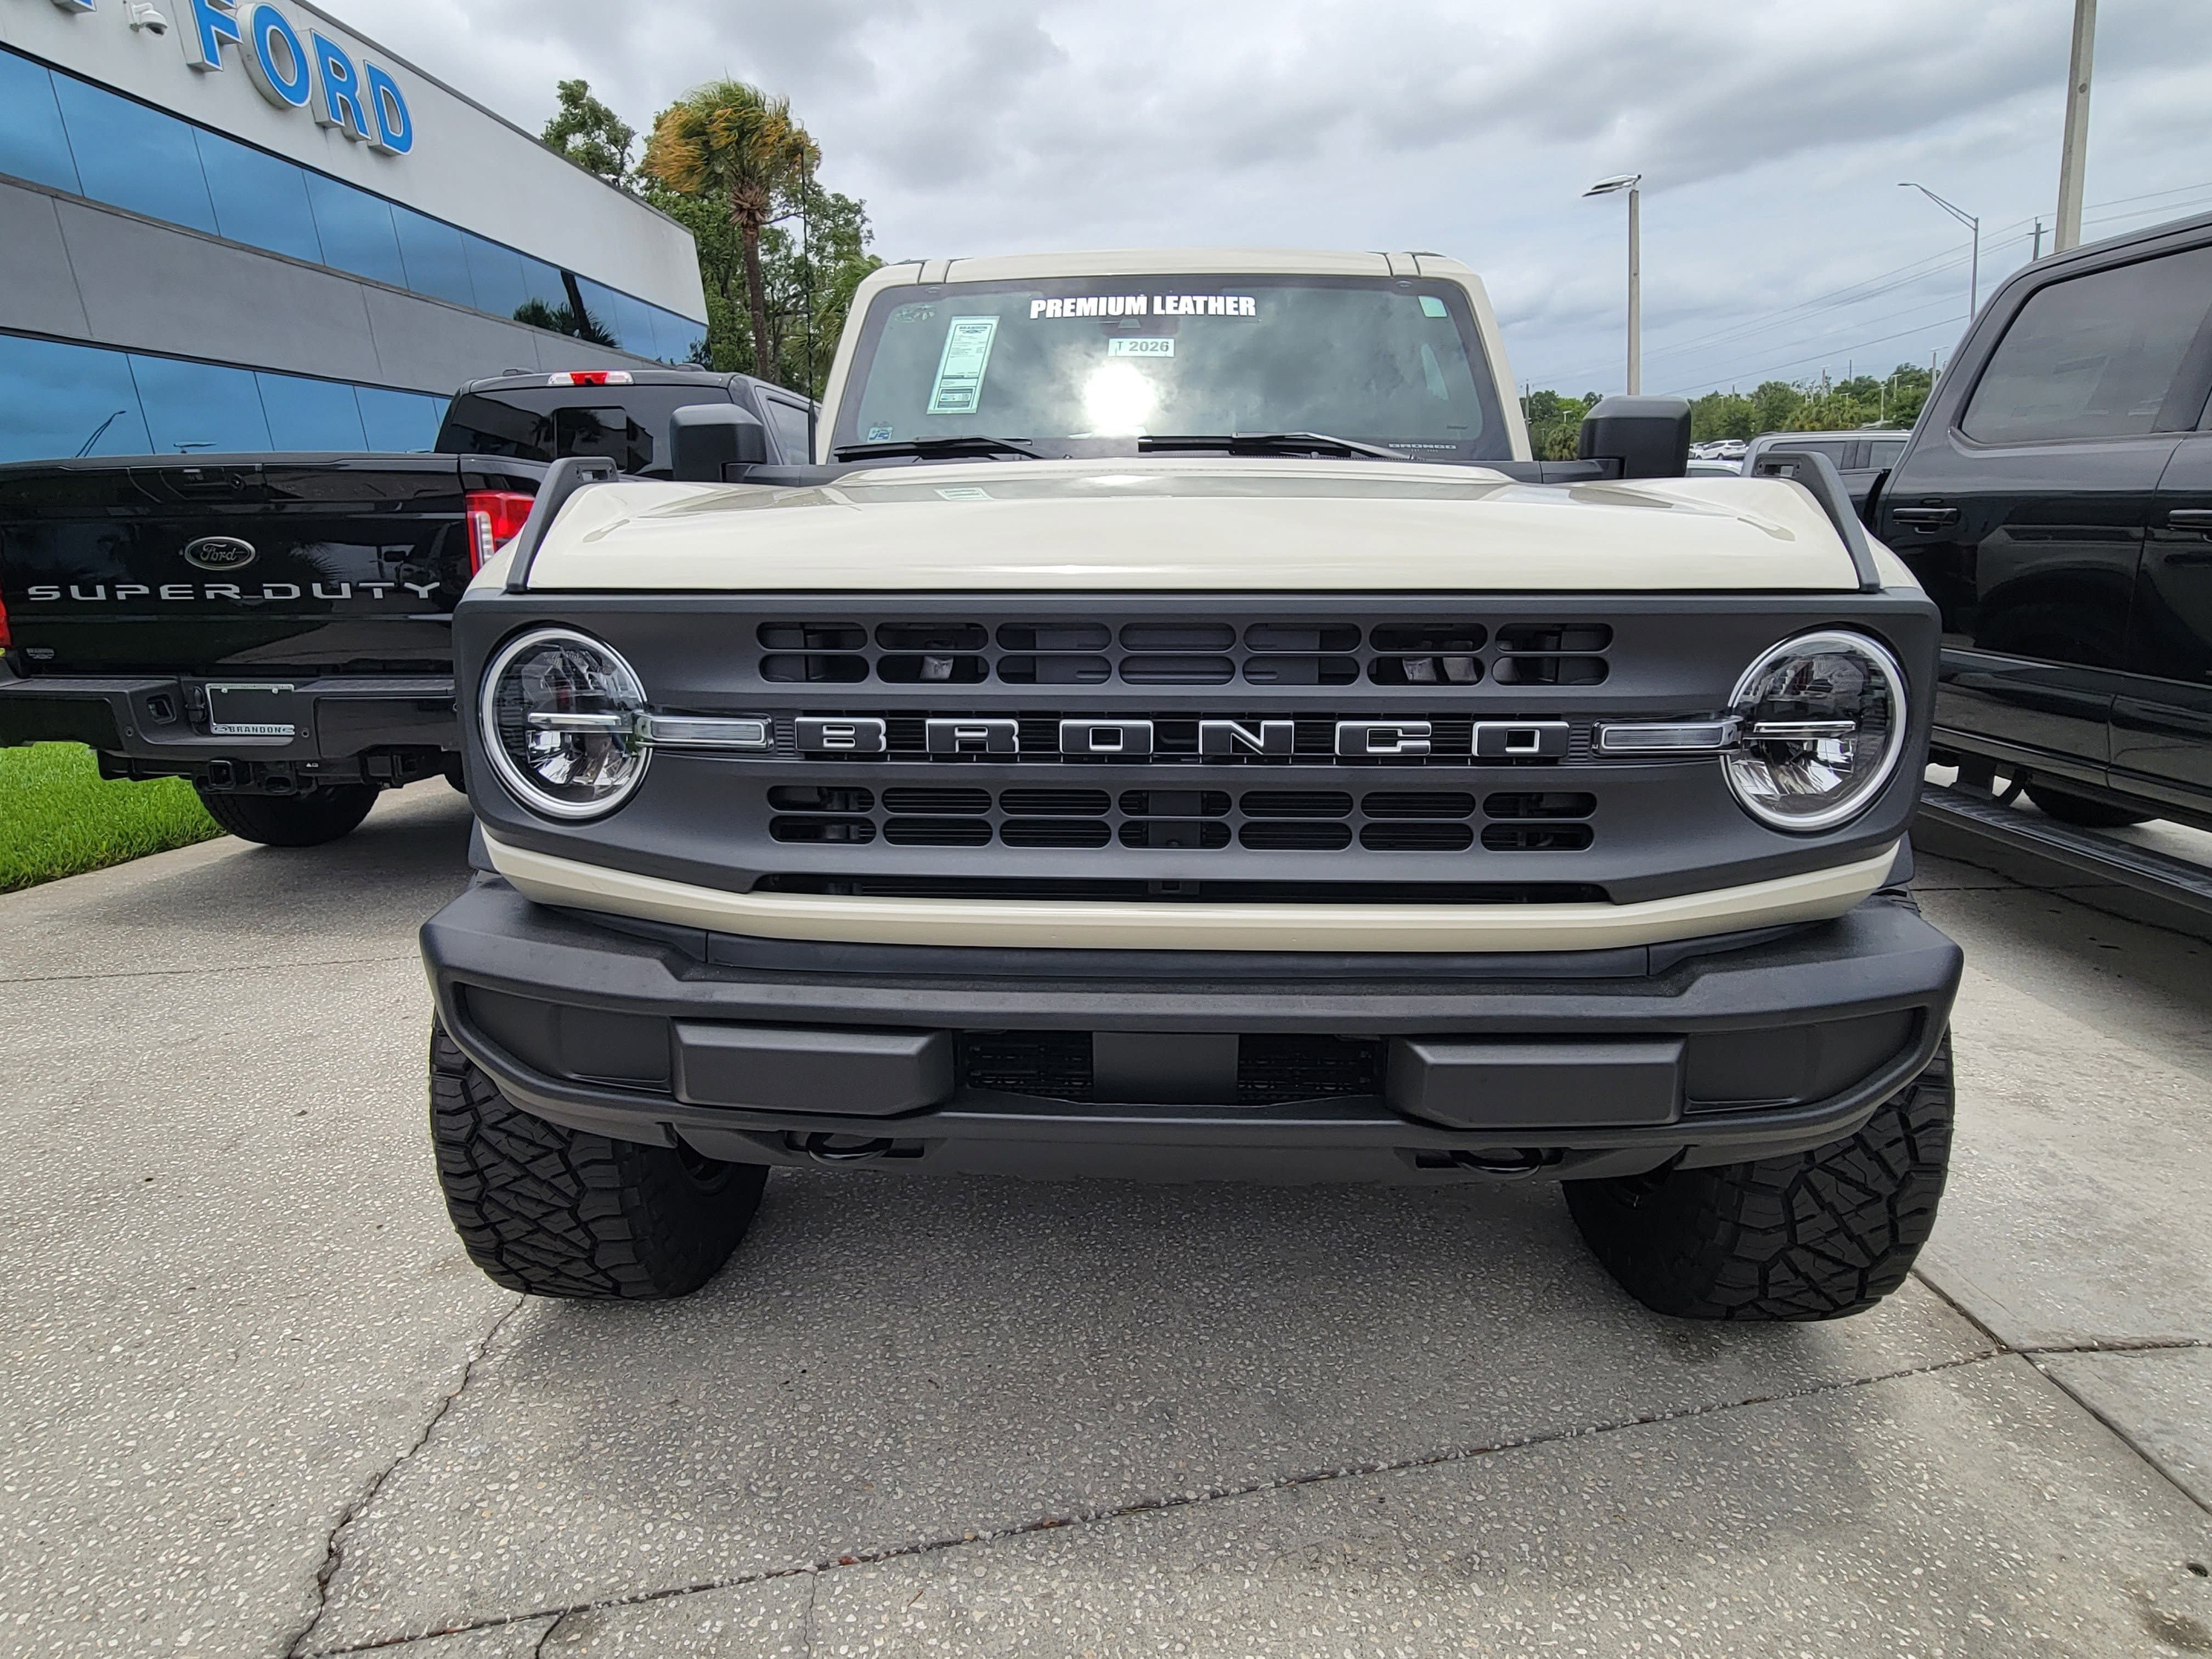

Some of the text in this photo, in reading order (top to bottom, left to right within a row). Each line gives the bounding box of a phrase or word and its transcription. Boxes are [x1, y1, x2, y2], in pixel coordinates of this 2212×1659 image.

[188, 0, 414, 156] FORD
[1030, 295, 1256, 320] PREMIUM LEATHER
[1129, 341, 1169, 352] 2026
[200, 543, 237, 561] Ford
[28, 582, 440, 601] SUPER DUTY
[794, 716, 1569, 757] BRONCO
